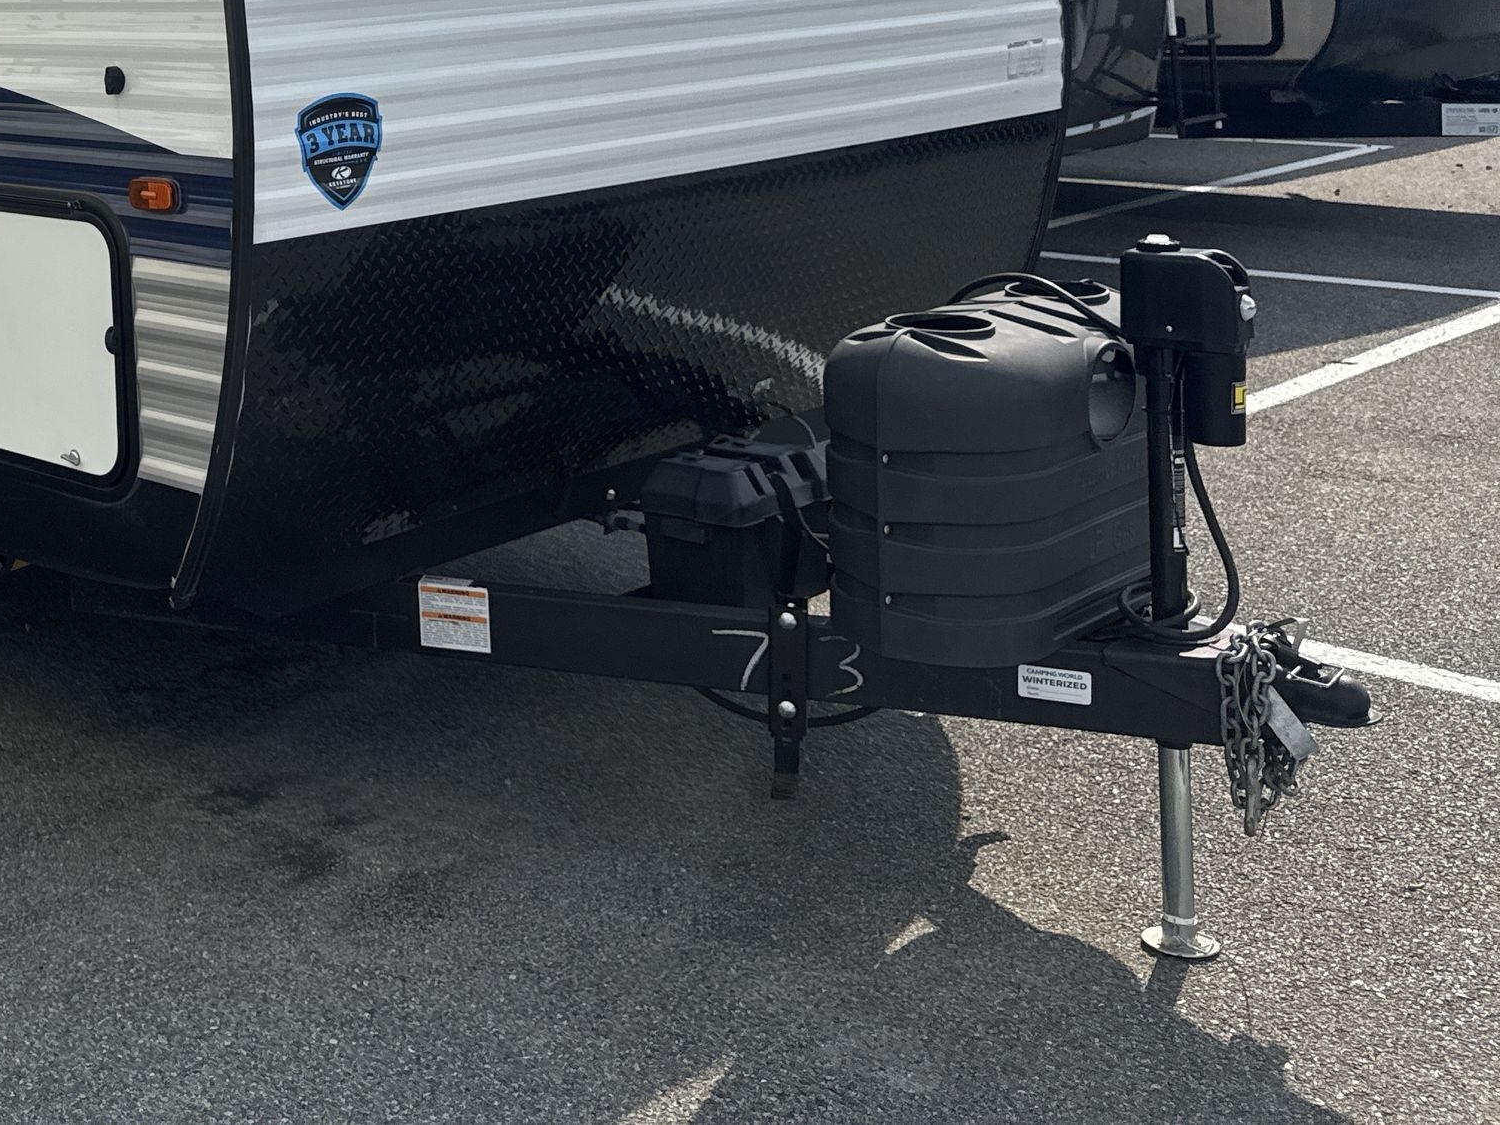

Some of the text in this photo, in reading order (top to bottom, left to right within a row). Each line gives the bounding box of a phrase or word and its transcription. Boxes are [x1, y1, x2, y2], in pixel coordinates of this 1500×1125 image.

[310, 111, 349, 126] INDUSTRY'S
[306, 123, 375, 154] 3 YEAR
[1027, 668, 1057, 677] CAMPING
[1022, 676, 1087, 690] WINTERIZED
